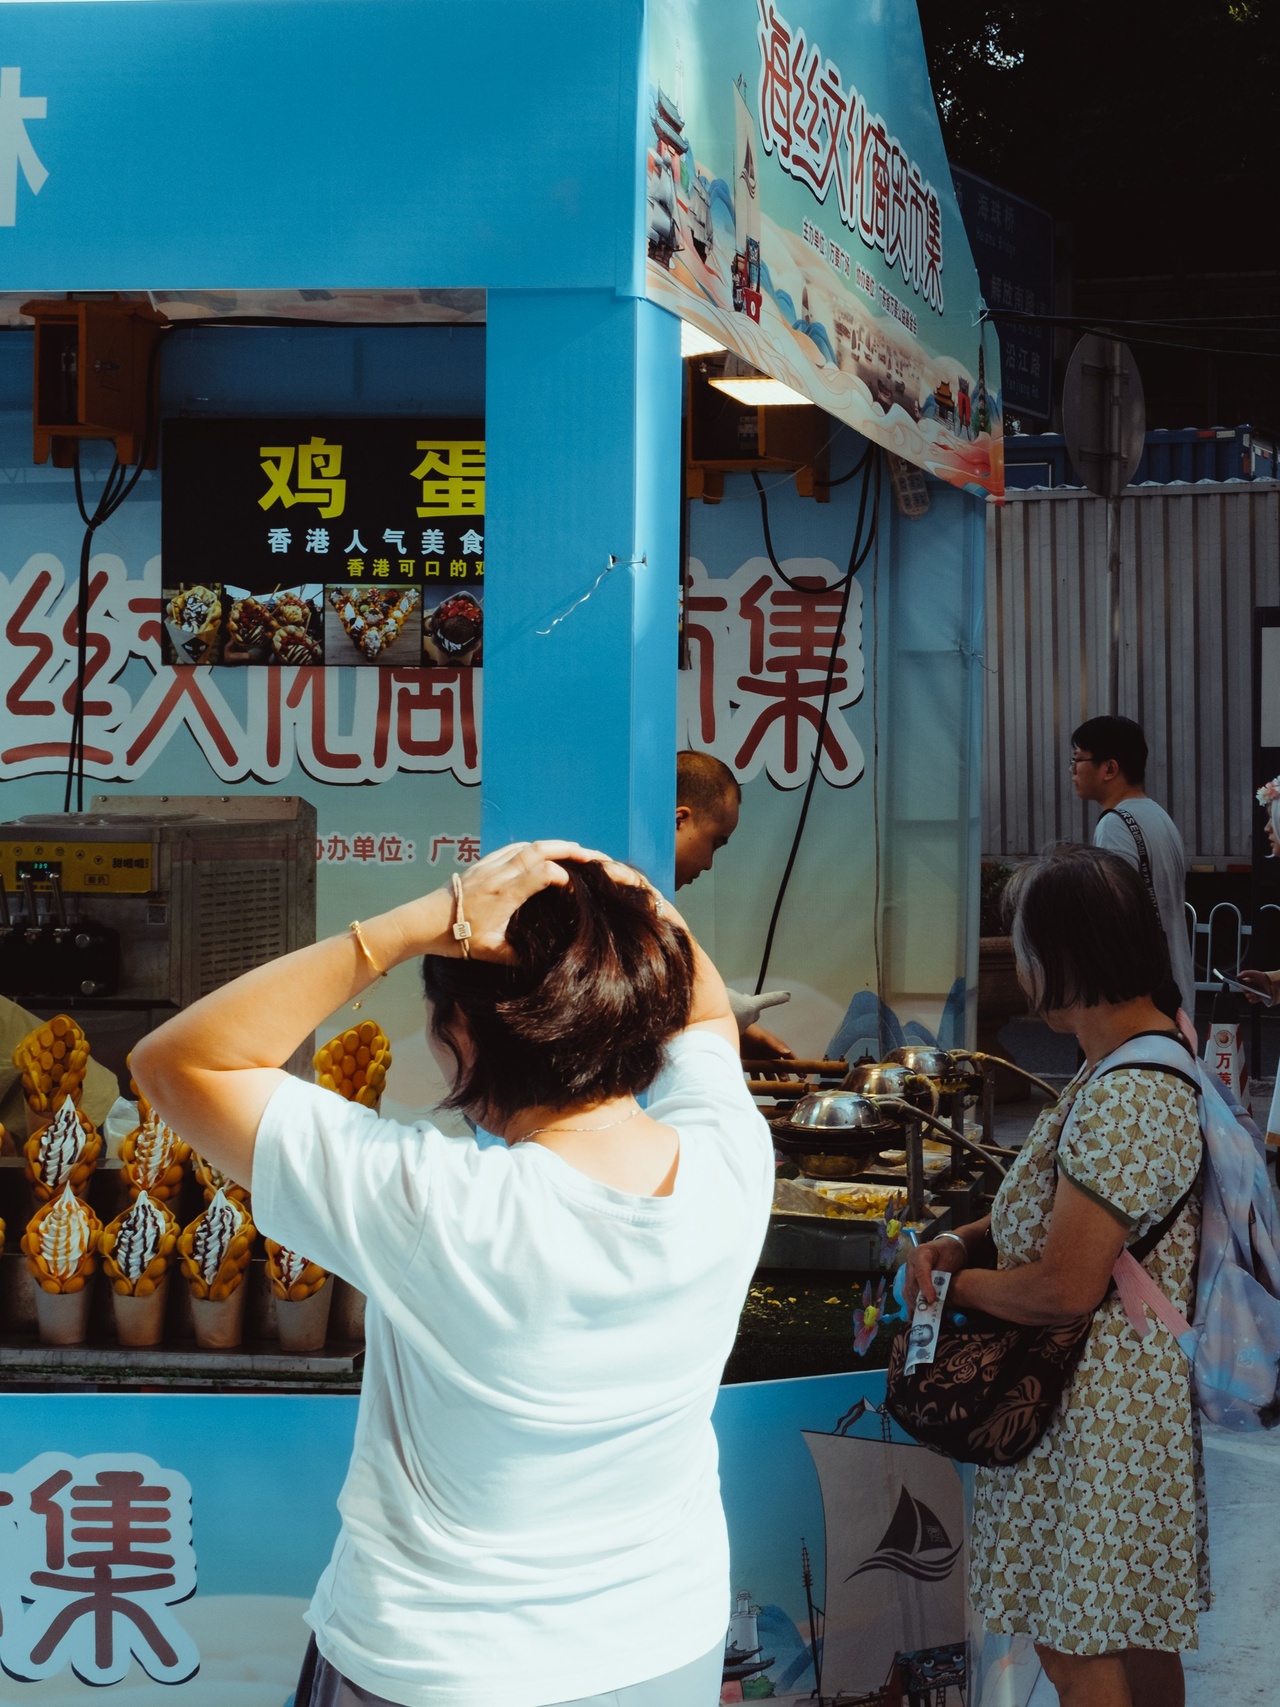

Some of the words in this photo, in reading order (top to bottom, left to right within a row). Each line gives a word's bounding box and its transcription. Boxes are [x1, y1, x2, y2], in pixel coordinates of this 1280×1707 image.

[977, 193, 1016, 234] 海珠桥
[1005, 341, 1041, 378] 沿江路
[267, 527, 485, 555] 香港人气美食
[0, 1469, 179, 1670] 集
